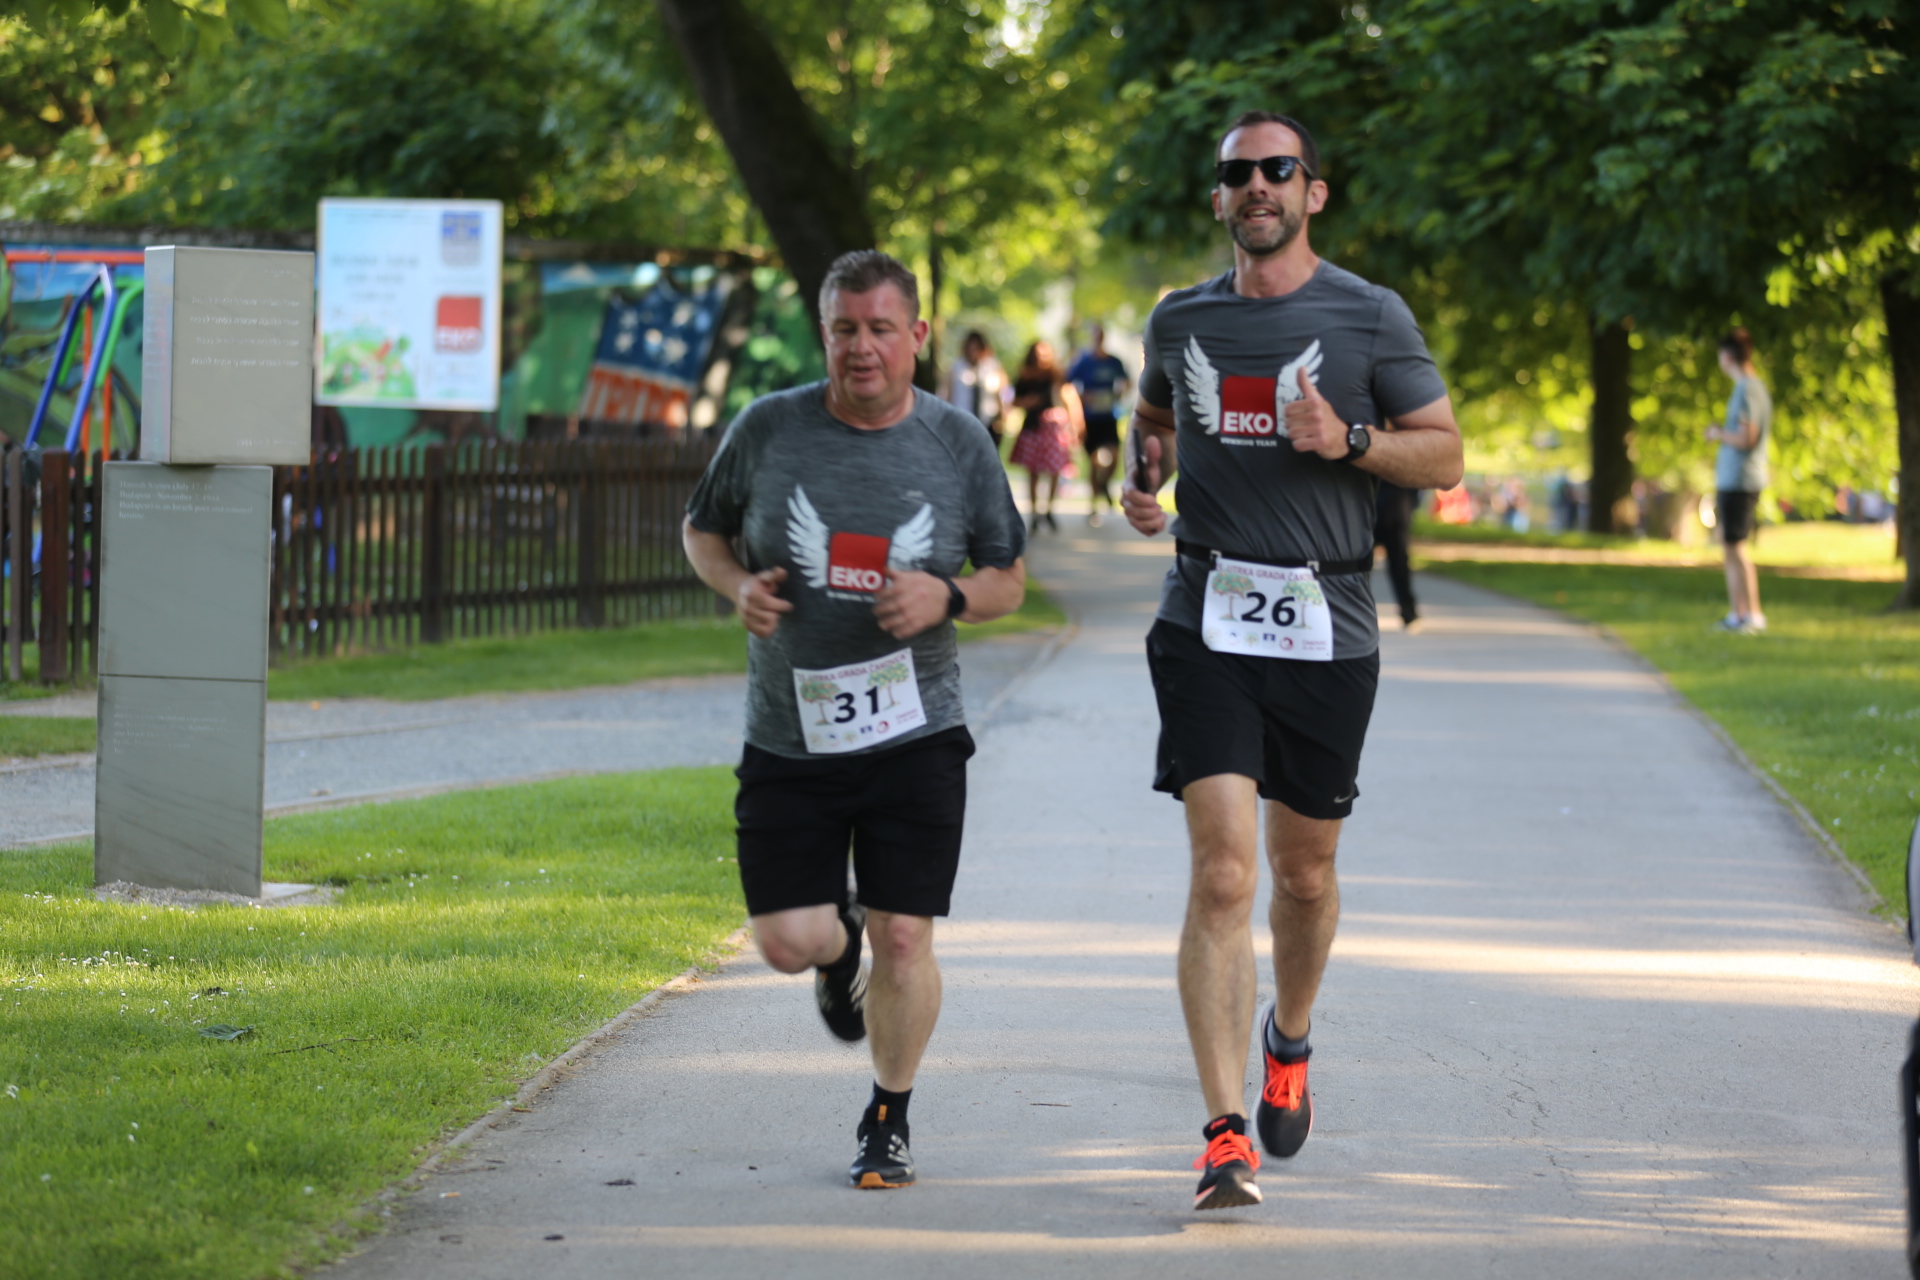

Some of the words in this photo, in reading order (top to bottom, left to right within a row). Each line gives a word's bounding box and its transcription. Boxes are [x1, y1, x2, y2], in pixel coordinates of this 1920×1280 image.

[1223, 411, 1274, 434] EKO
[830, 565, 883, 590] EKO
[1241, 591, 1296, 627] 26
[834, 685, 880, 724] 31
